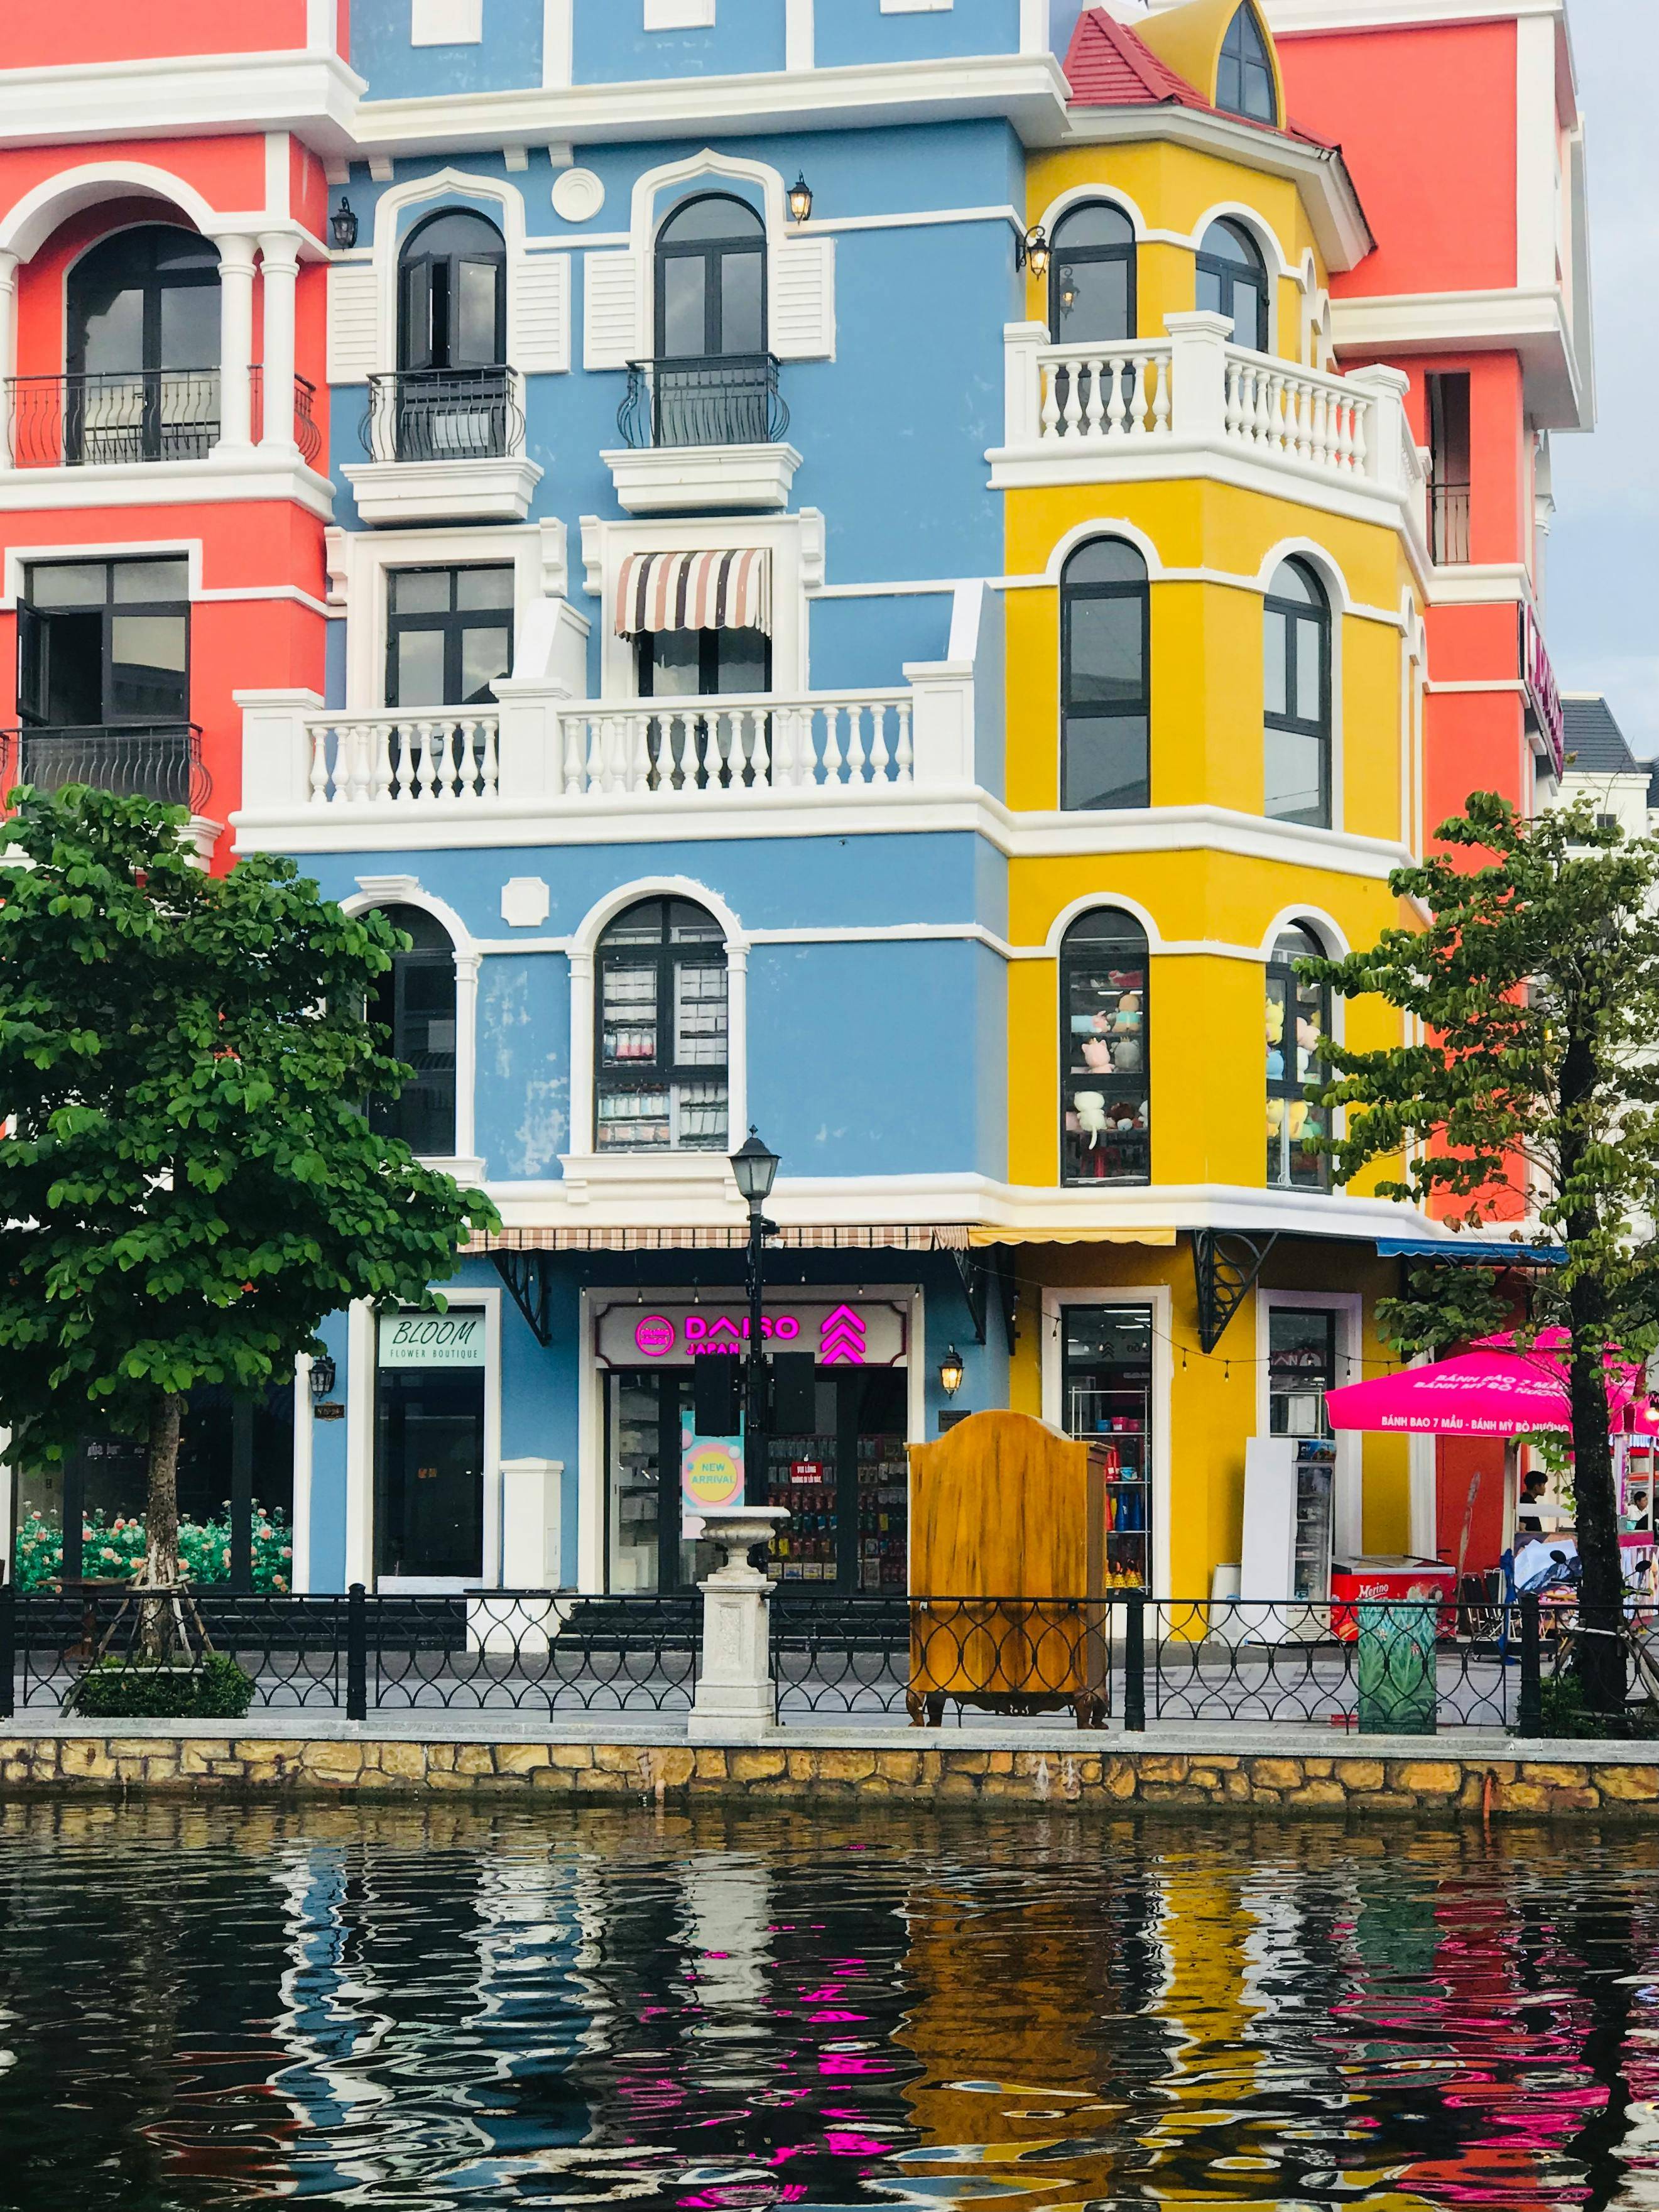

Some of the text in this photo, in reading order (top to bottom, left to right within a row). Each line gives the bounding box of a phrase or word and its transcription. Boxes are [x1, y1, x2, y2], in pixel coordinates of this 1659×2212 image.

[393, 1321, 477, 1345] BLOOM
[390, 1349, 477, 1359] FLOWER BOUTIQUE
[686, 1342, 739, 1355] JAPAN
[1381, 1414, 1408, 1426] BÁNH
[1410, 1417, 1430, 1427] BAO
[1433, 1418, 1439, 1427] 7
[1471, 1417, 1497, 1430] BÁNH
[702, 1463, 724, 1471] NEW
[692, 1475, 734, 1485] ARRIVAL
[1358, 1583, 1389, 1598] Merino
